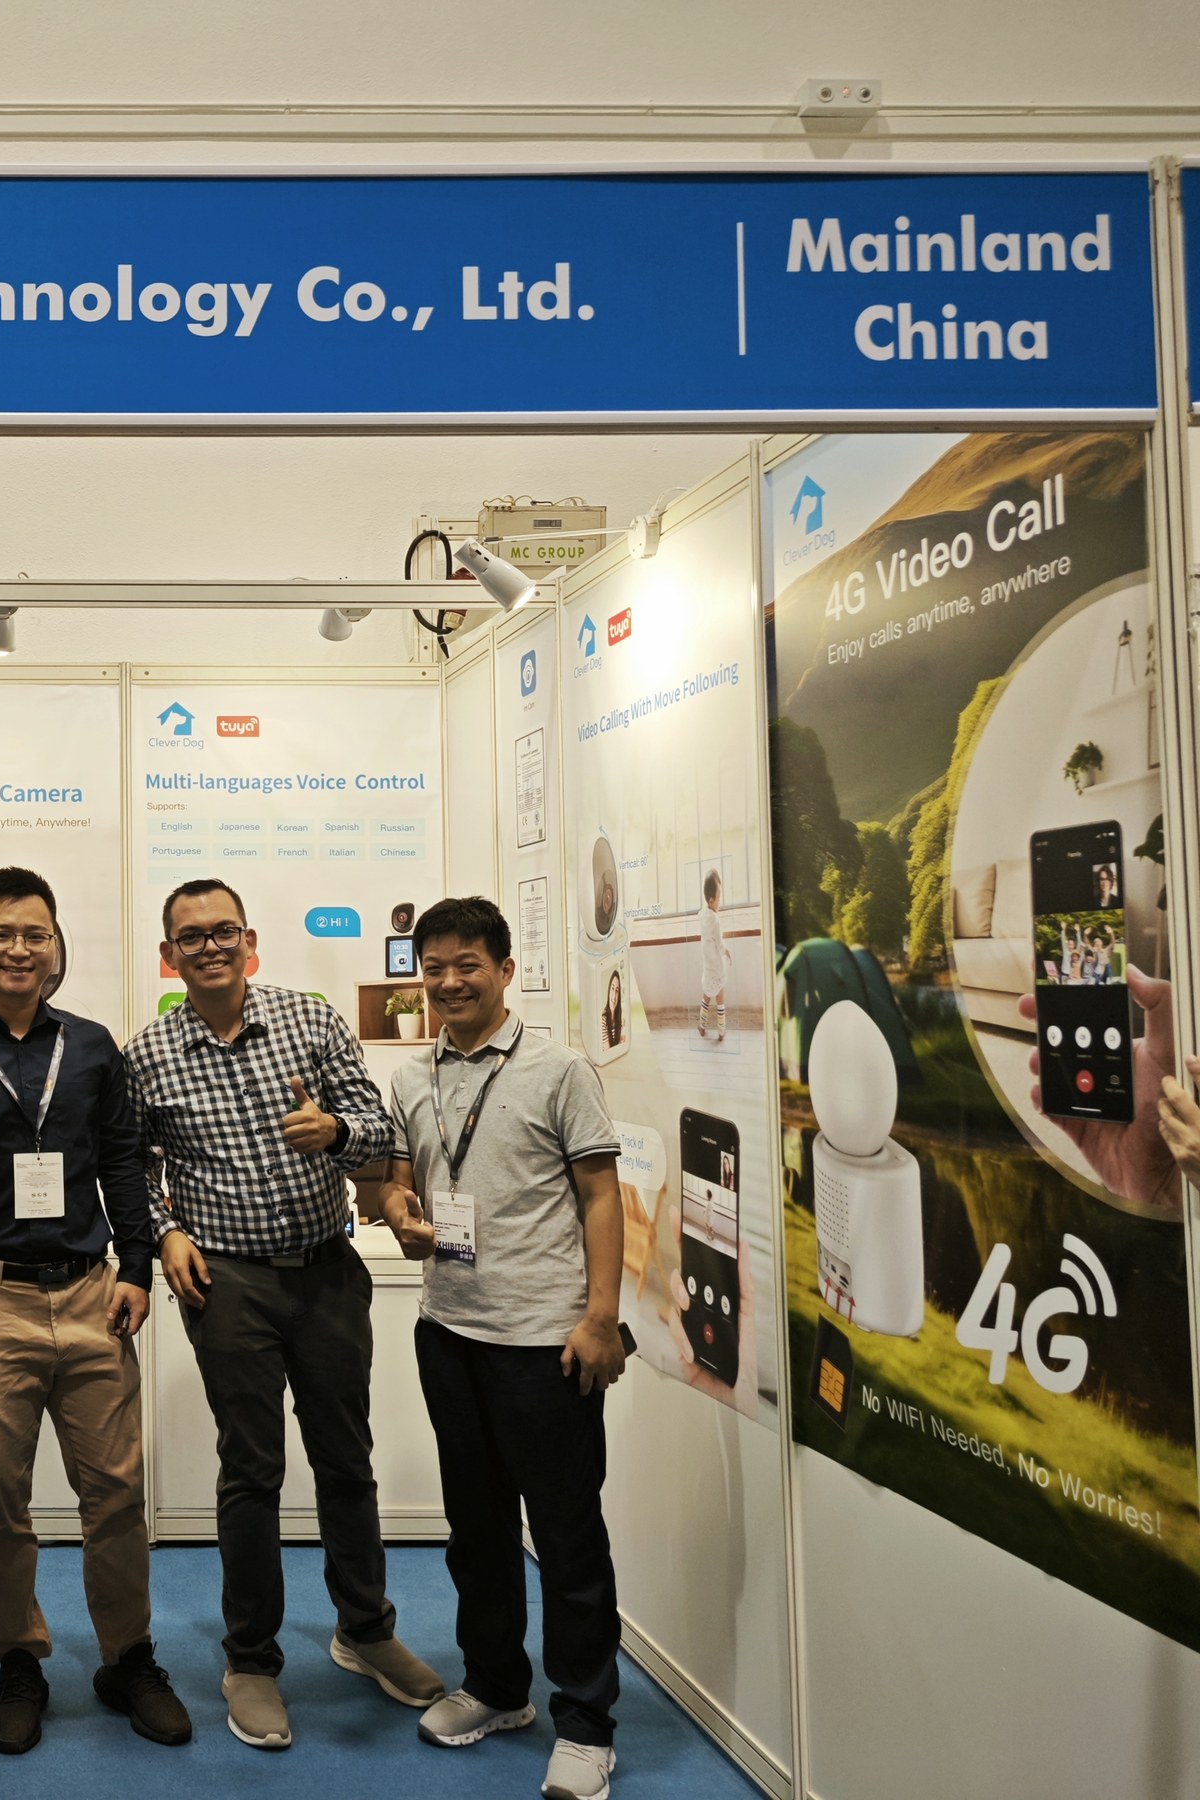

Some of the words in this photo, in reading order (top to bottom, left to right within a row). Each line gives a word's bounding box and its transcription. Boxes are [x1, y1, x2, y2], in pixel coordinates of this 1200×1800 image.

[786, 214, 1111, 273] Mainland
[297, 265, 433, 331] Co.,
[463, 262, 594, 321] Ltd.
[854, 303, 1048, 361] China
[511, 547, 530, 558] MC
[537, 547, 585, 558] GROUP
[783, 540, 812, 566] Clever
[814, 529, 836, 551] Dog
[824, 571, 866, 621] 4G
[875, 531, 973, 600] Video
[987, 473, 1065, 552] Call
[828, 636, 865, 665] Enjoy
[869, 620, 902, 649] calls
[907, 594, 976, 634] anytime,
[981, 556, 1071, 606] anywhere
[609, 617, 629, 639] tuya
[574, 663, 589, 679] Clever
[590, 657, 602, 671] Dog
[578, 722, 598, 742] Video
[600, 709, 630, 733] Calling
[630, 696, 651, 720] With
[654, 688, 680, 711] Move
[683, 663, 739, 699] Following
[219, 719, 255, 734] tuya
[148, 738, 182, 748] Clever
[182, 738, 204, 750] Dog
[0, 784, 84, 803] Camera
[145, 773, 293, 794] Multi-languages
[296, 773, 347, 790] Voice
[355, 773, 425, 790] Control
[146, 802, 188, 812] Supports:
[35, 817, 91, 829] Anywhere!
[161, 822, 193, 833] English
[218, 822, 260, 833] Japanese
[277, 824, 309, 832] Korean
[324, 822, 360, 833] Spanish
[380, 823, 415, 832] Russian
[152, 846, 202, 857] Portuguese
[222, 848, 257, 857] German
[278, 848, 308, 857] French
[329, 848, 356, 857] Italian
[380, 848, 416, 857] Chinese
[330, 917, 342, 927] Hi
[622, 1134, 636, 1149] Track
[637, 1138, 644, 1150] of
[635, 1158, 653, 1172] Move!
[437, 1240, 473, 1253] XHIBITOR
[955, 1242, 1089, 1394] 4G
[862, 1384, 881, 1413] No
[886, 1395, 926, 1433] WIFI
[930, 1415, 1012, 1476] Needed,
[1018, 1452, 1050, 1488] No
[1058, 1468, 1162, 1539] Worries!
